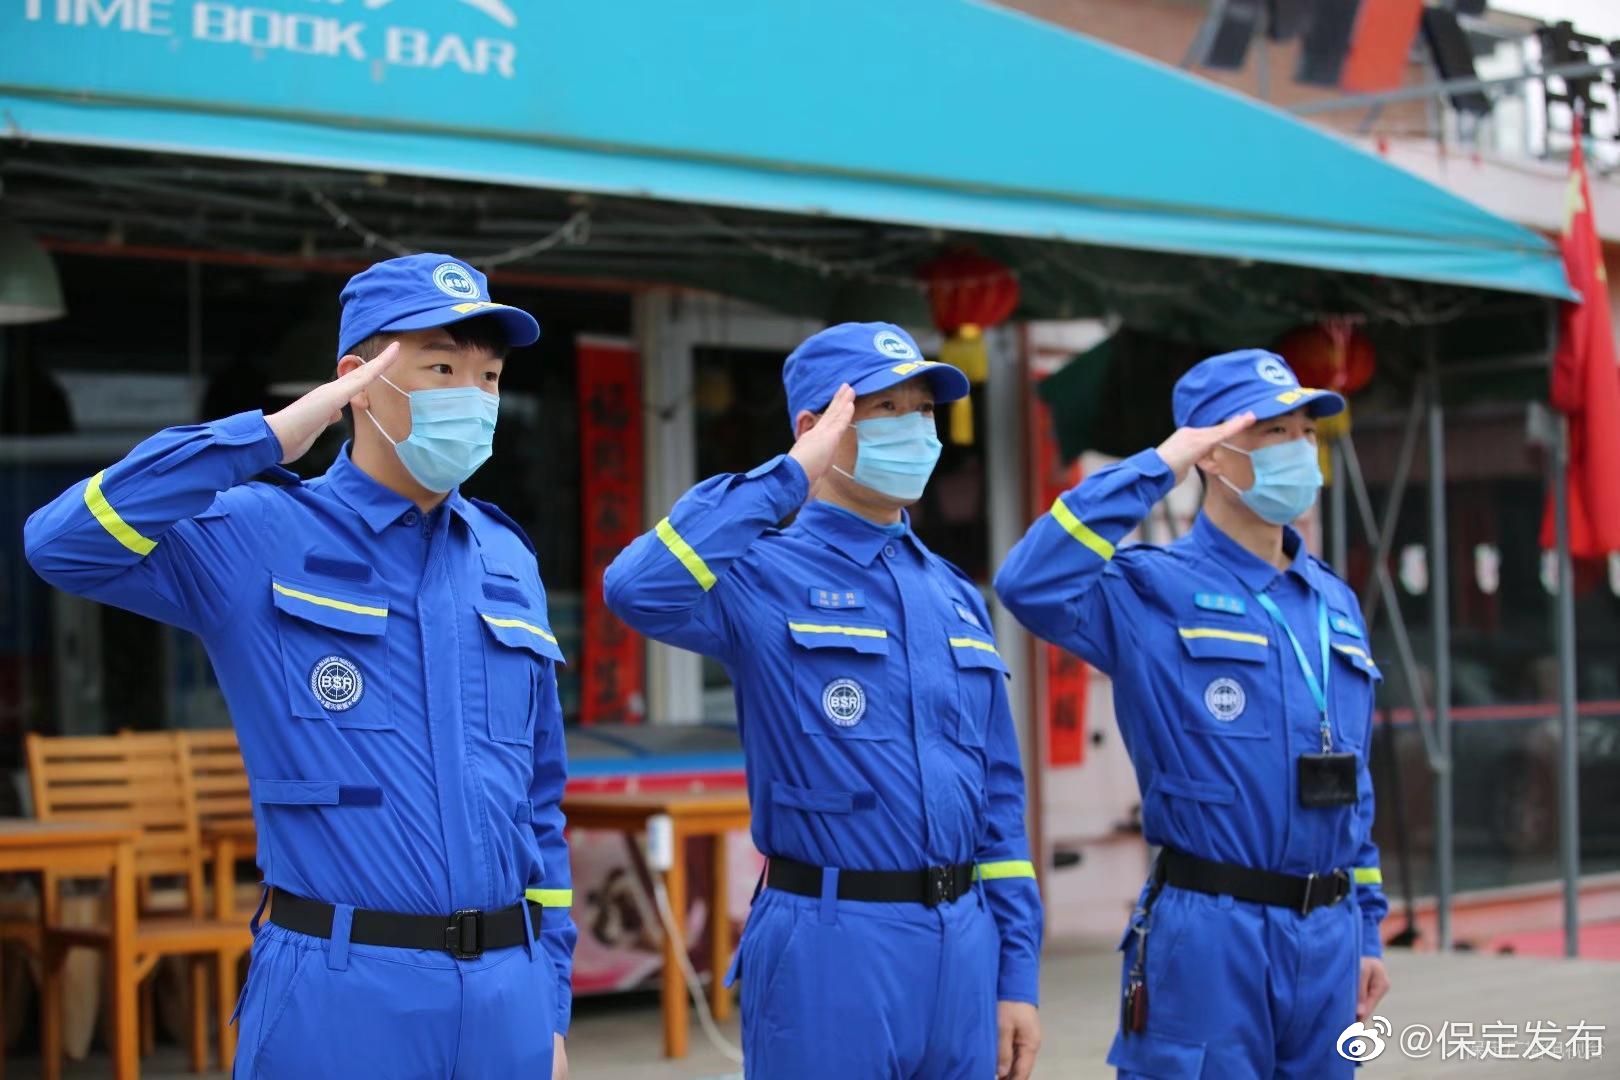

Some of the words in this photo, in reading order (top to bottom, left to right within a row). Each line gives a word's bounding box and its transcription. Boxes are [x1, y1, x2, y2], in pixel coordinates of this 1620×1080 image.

[191, 2, 366, 61] BOOK
[386, 26, 517, 79] BAR
[322, 676, 353, 690] BSR
[830, 696, 858, 709] BSR
